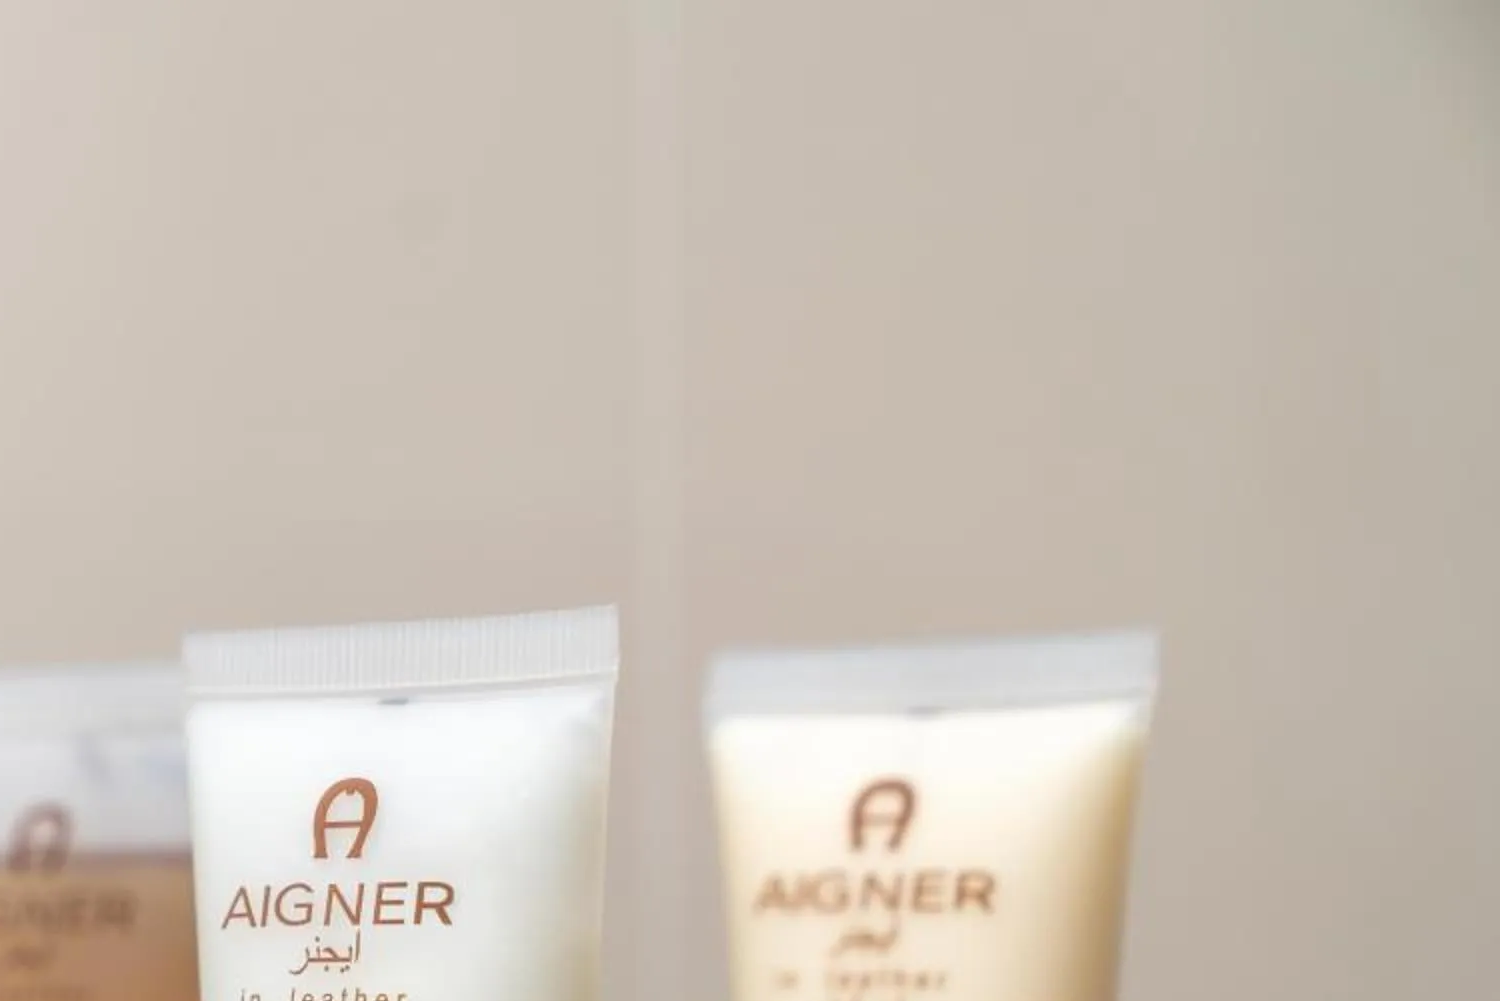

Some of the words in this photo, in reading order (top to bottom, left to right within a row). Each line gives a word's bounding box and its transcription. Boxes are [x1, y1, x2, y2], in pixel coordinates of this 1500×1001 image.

[221, 881, 456, 930] AIGNER
[752, 869, 999, 914] AIGNER
[289, 928, 361, 975] ايجنر
